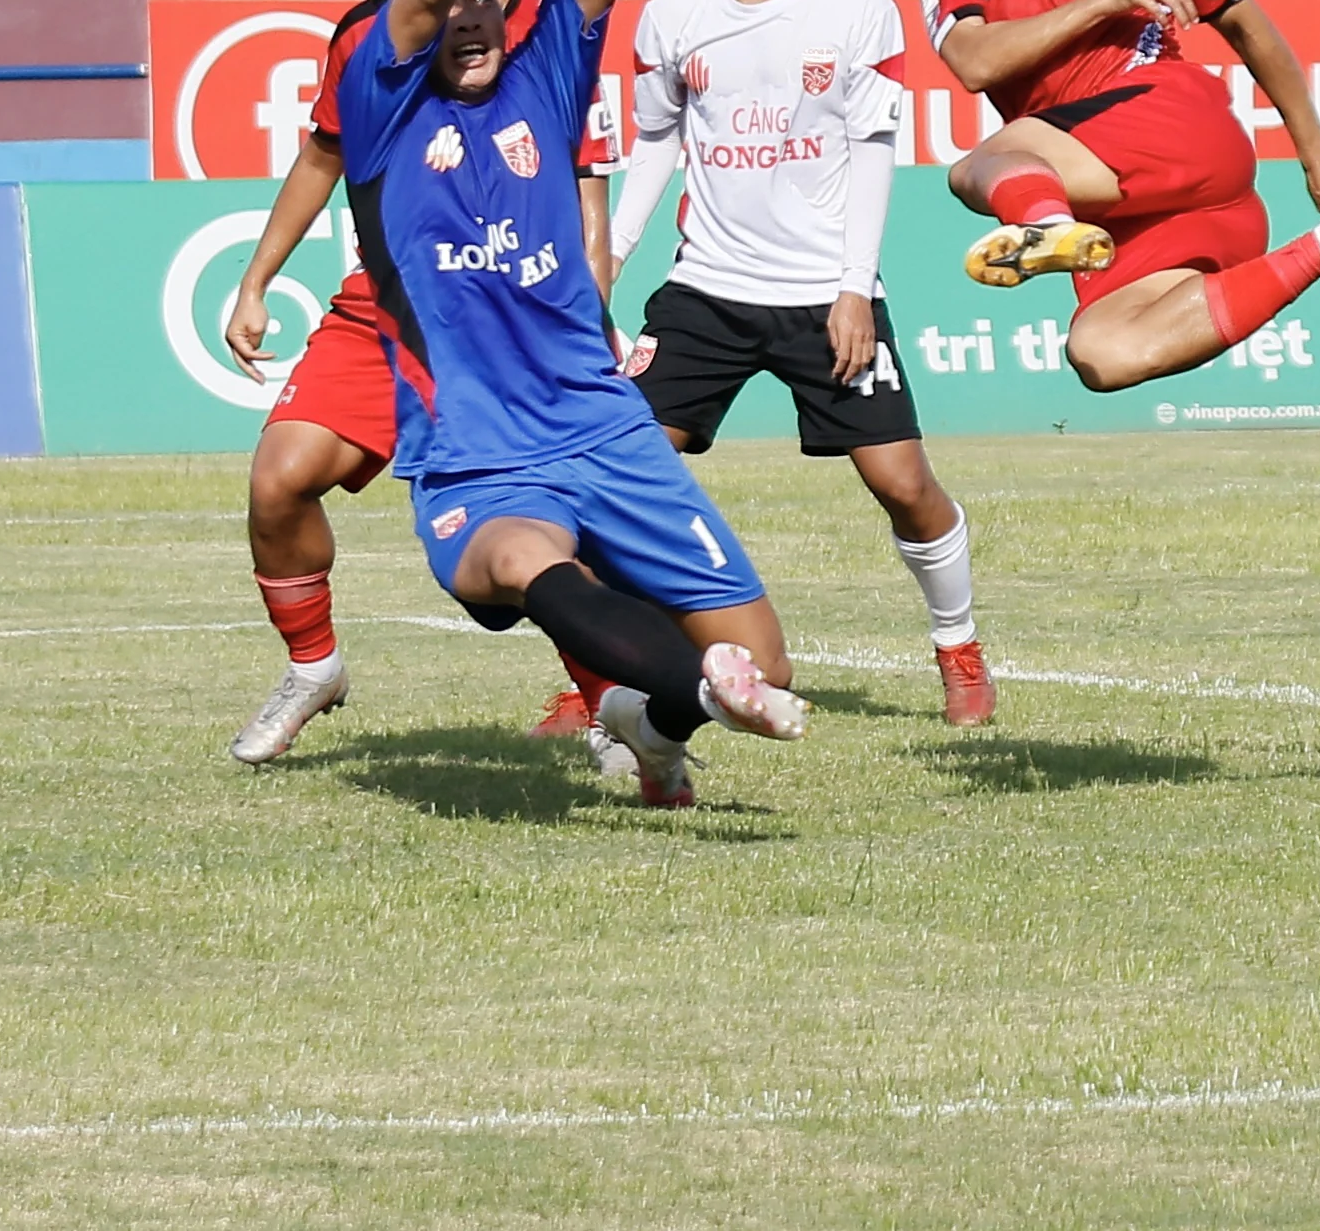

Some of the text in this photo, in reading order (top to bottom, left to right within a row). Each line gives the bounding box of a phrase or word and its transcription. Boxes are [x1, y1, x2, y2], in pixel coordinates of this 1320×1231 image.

[732, 100, 790, 135] CẢNG
[781, 135, 825, 162] AN
[519, 242, 560, 288] AN
[918, 318, 996, 373] tri
[690, 515, 728, 569] 1
